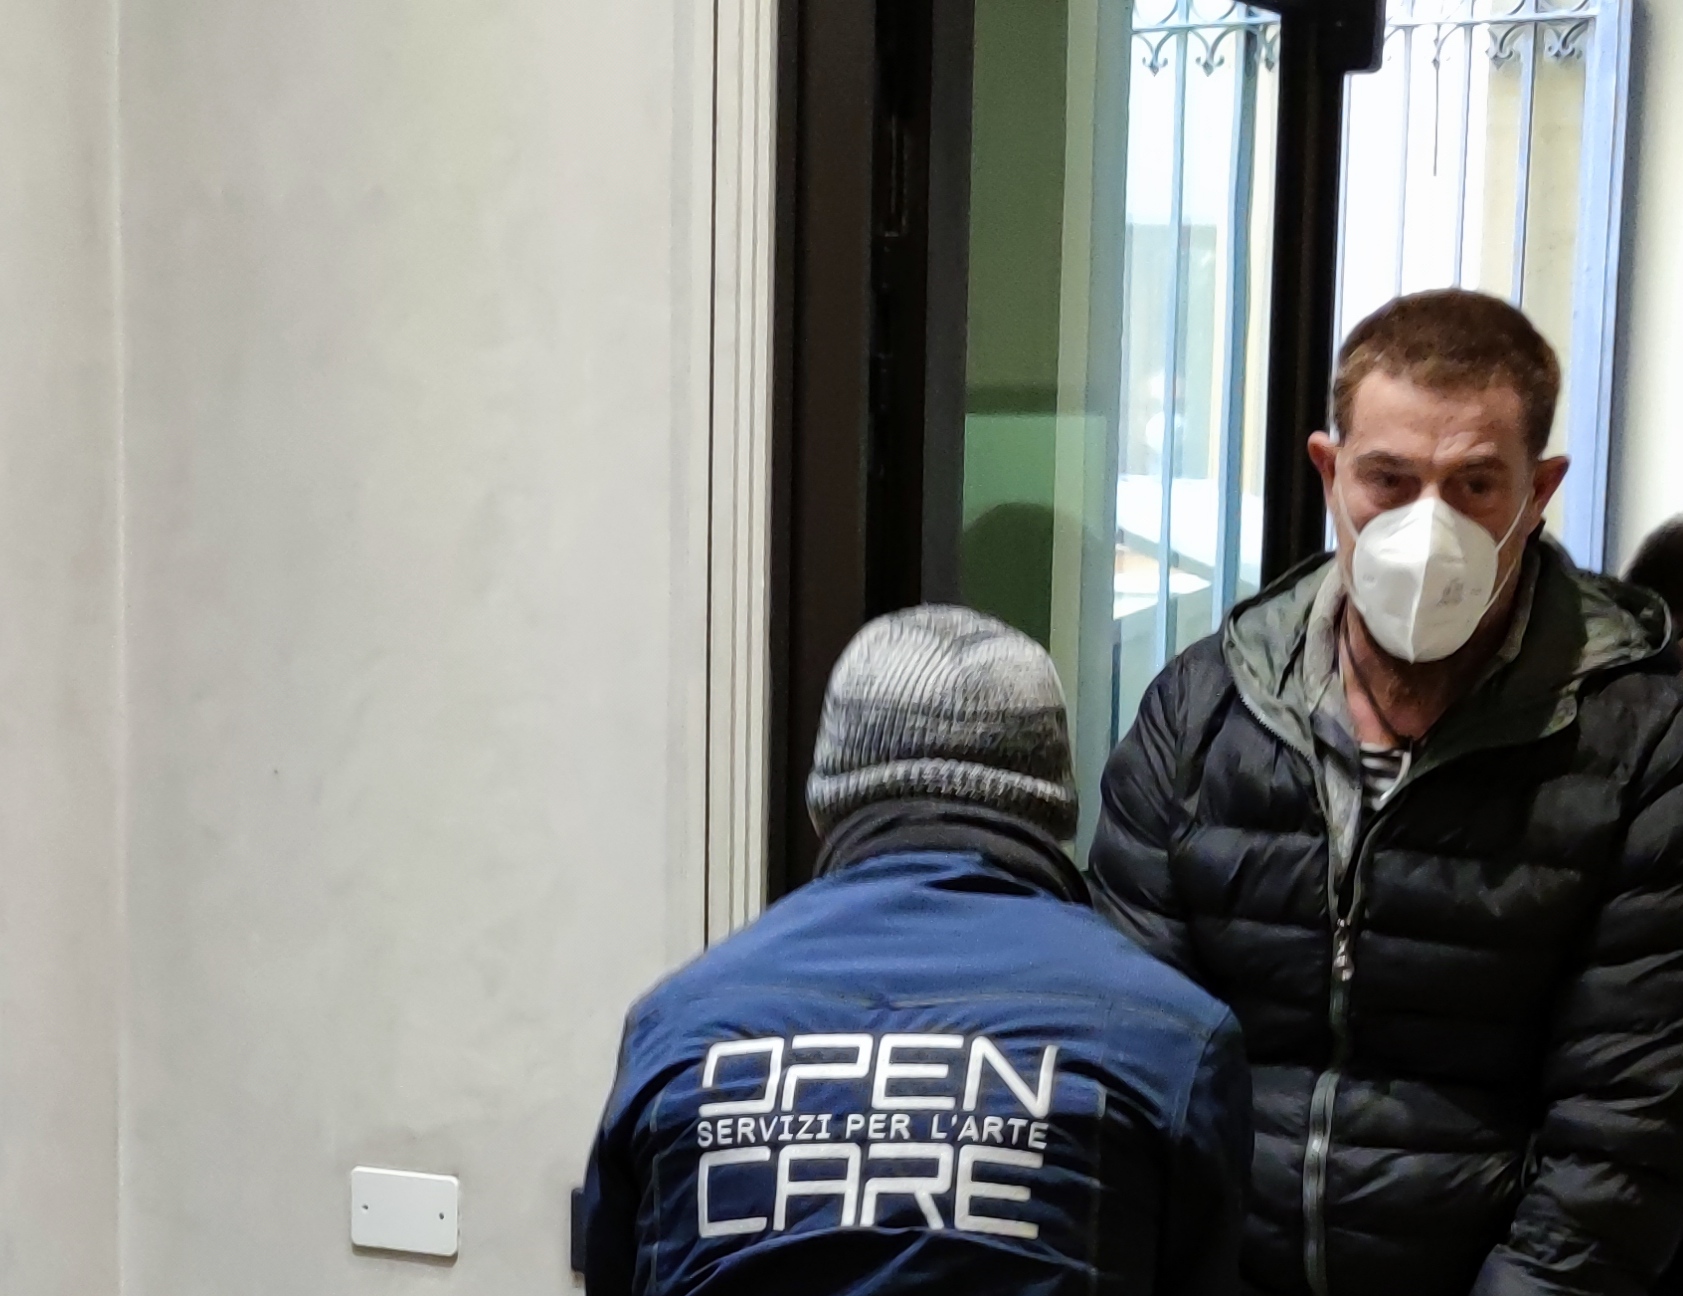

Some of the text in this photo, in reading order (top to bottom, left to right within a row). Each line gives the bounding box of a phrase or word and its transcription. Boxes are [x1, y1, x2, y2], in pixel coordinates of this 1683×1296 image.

[700, 1034, 1059, 1118] OPEN
[697, 1113, 1049, 1149] SERVIZI PER L'ARTE
[698, 1143, 1044, 1239] CARE
